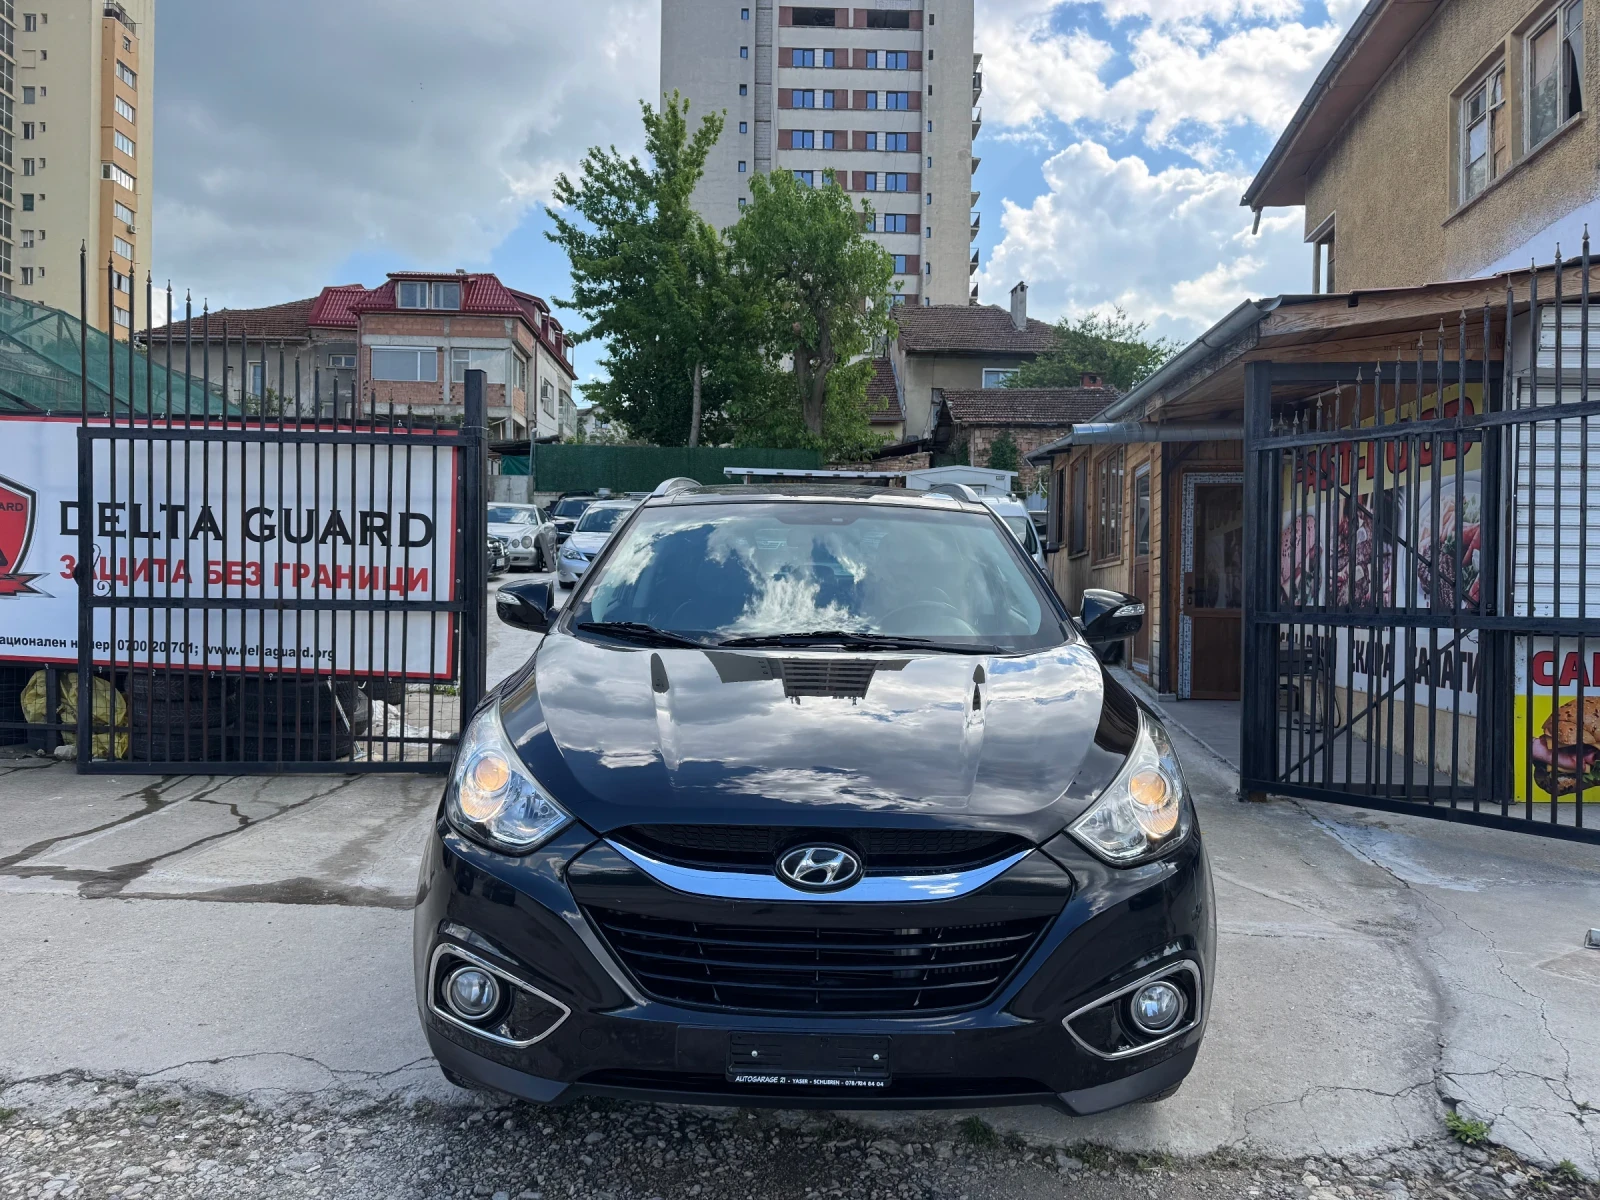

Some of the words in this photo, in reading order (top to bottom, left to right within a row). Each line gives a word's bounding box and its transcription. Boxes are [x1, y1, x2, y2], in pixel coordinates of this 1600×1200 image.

[59, 500, 223, 540] DELTA
[244, 506, 433, 548] GUARD
[59, 554, 193, 587] ЗЩИТА
[207, 560, 261, 587] БЕЗ
[273, 562, 429, 597] ГРАНИЦИ
[71, 638, 110, 653] нер
[117, 639, 147, 652] 0700
[151, 641, 168, 653] 20
[203, 643, 335, 662] www.elaguad.rg
[1349, 639, 1394, 679] КРА
[1409, 645, 1480, 695] ААТИ
[735, 1075, 778, 1084] AUTOGARAGE
